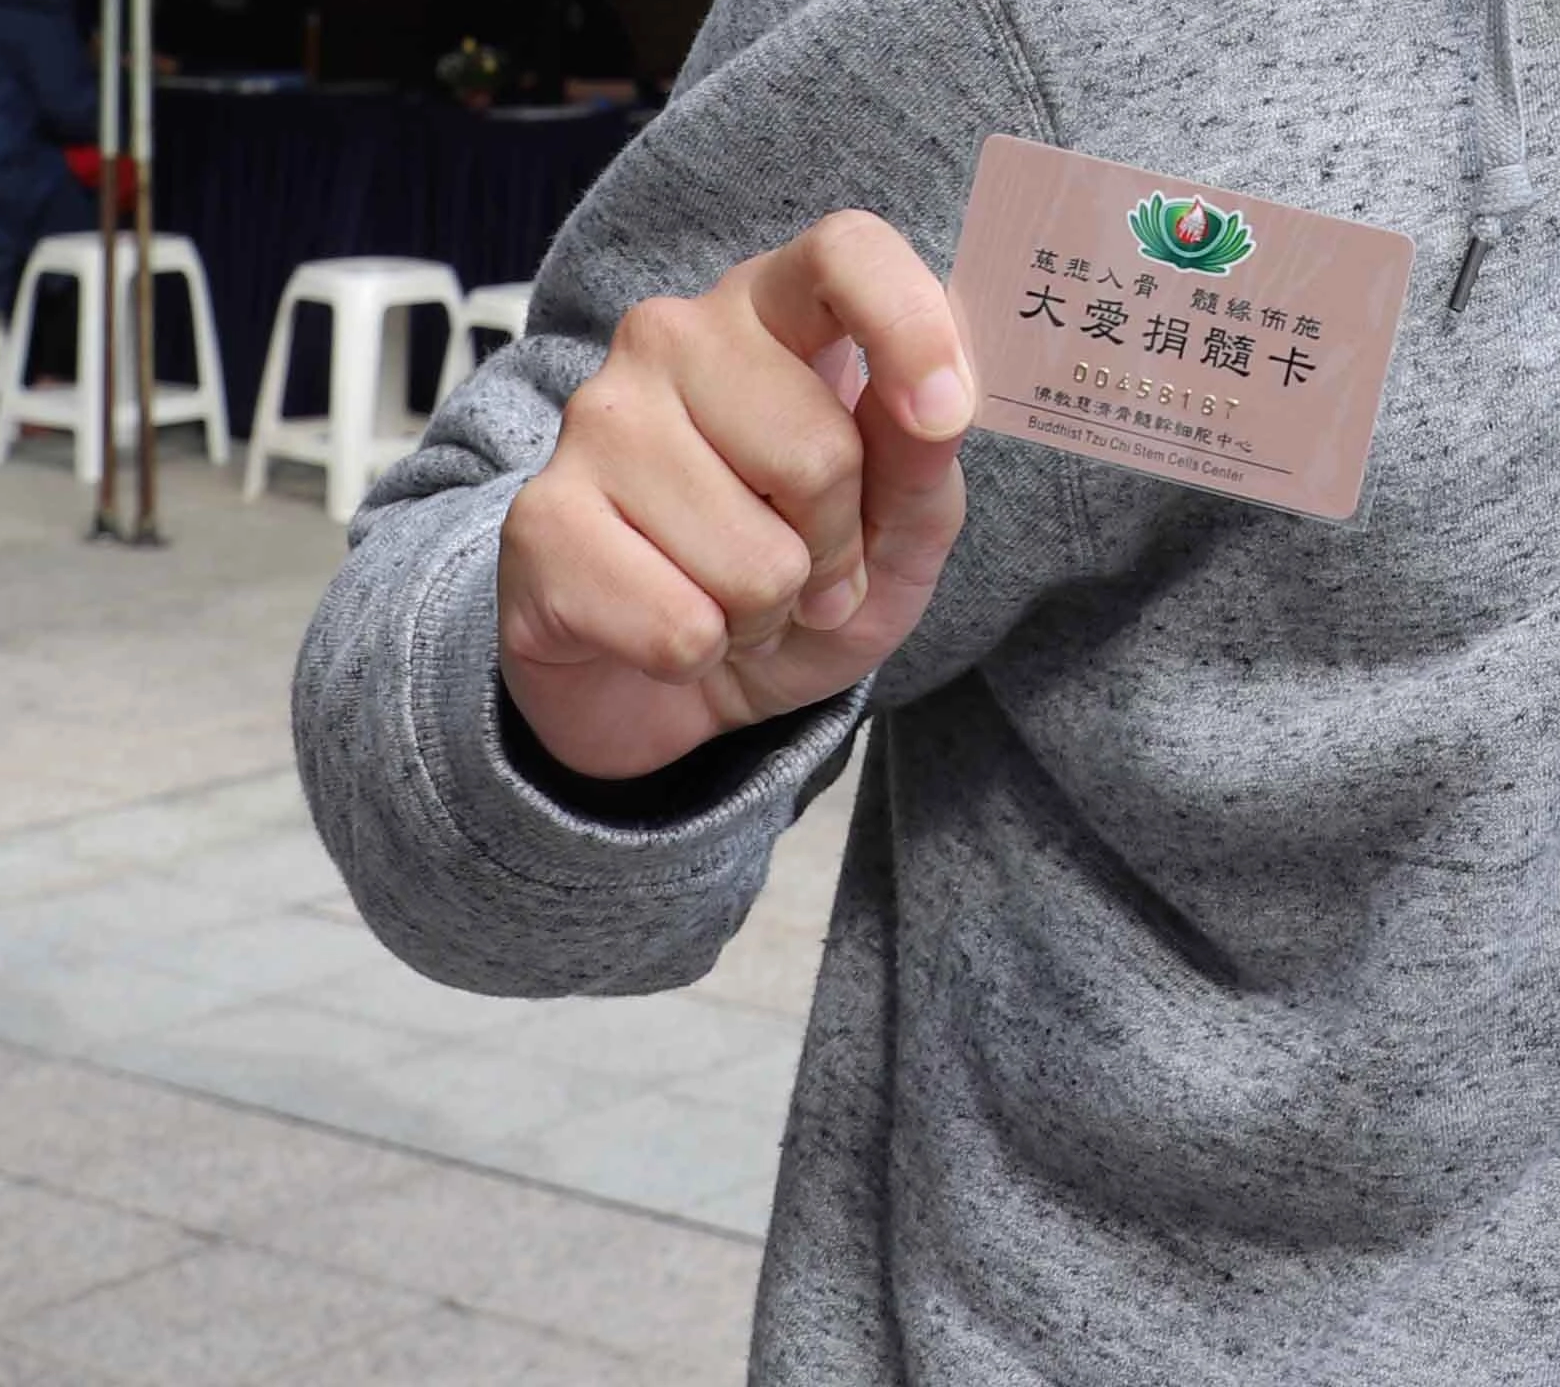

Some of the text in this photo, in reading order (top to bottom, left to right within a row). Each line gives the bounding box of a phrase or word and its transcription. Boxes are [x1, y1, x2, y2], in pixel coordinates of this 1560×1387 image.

[1030, 248, 1159, 299] 慈悲入骨
[1019, 285, 1316, 387] 大愛捐髓卡
[1028, 415, 1244, 483] Buddhist Tzu Chi Stem Cells Center
